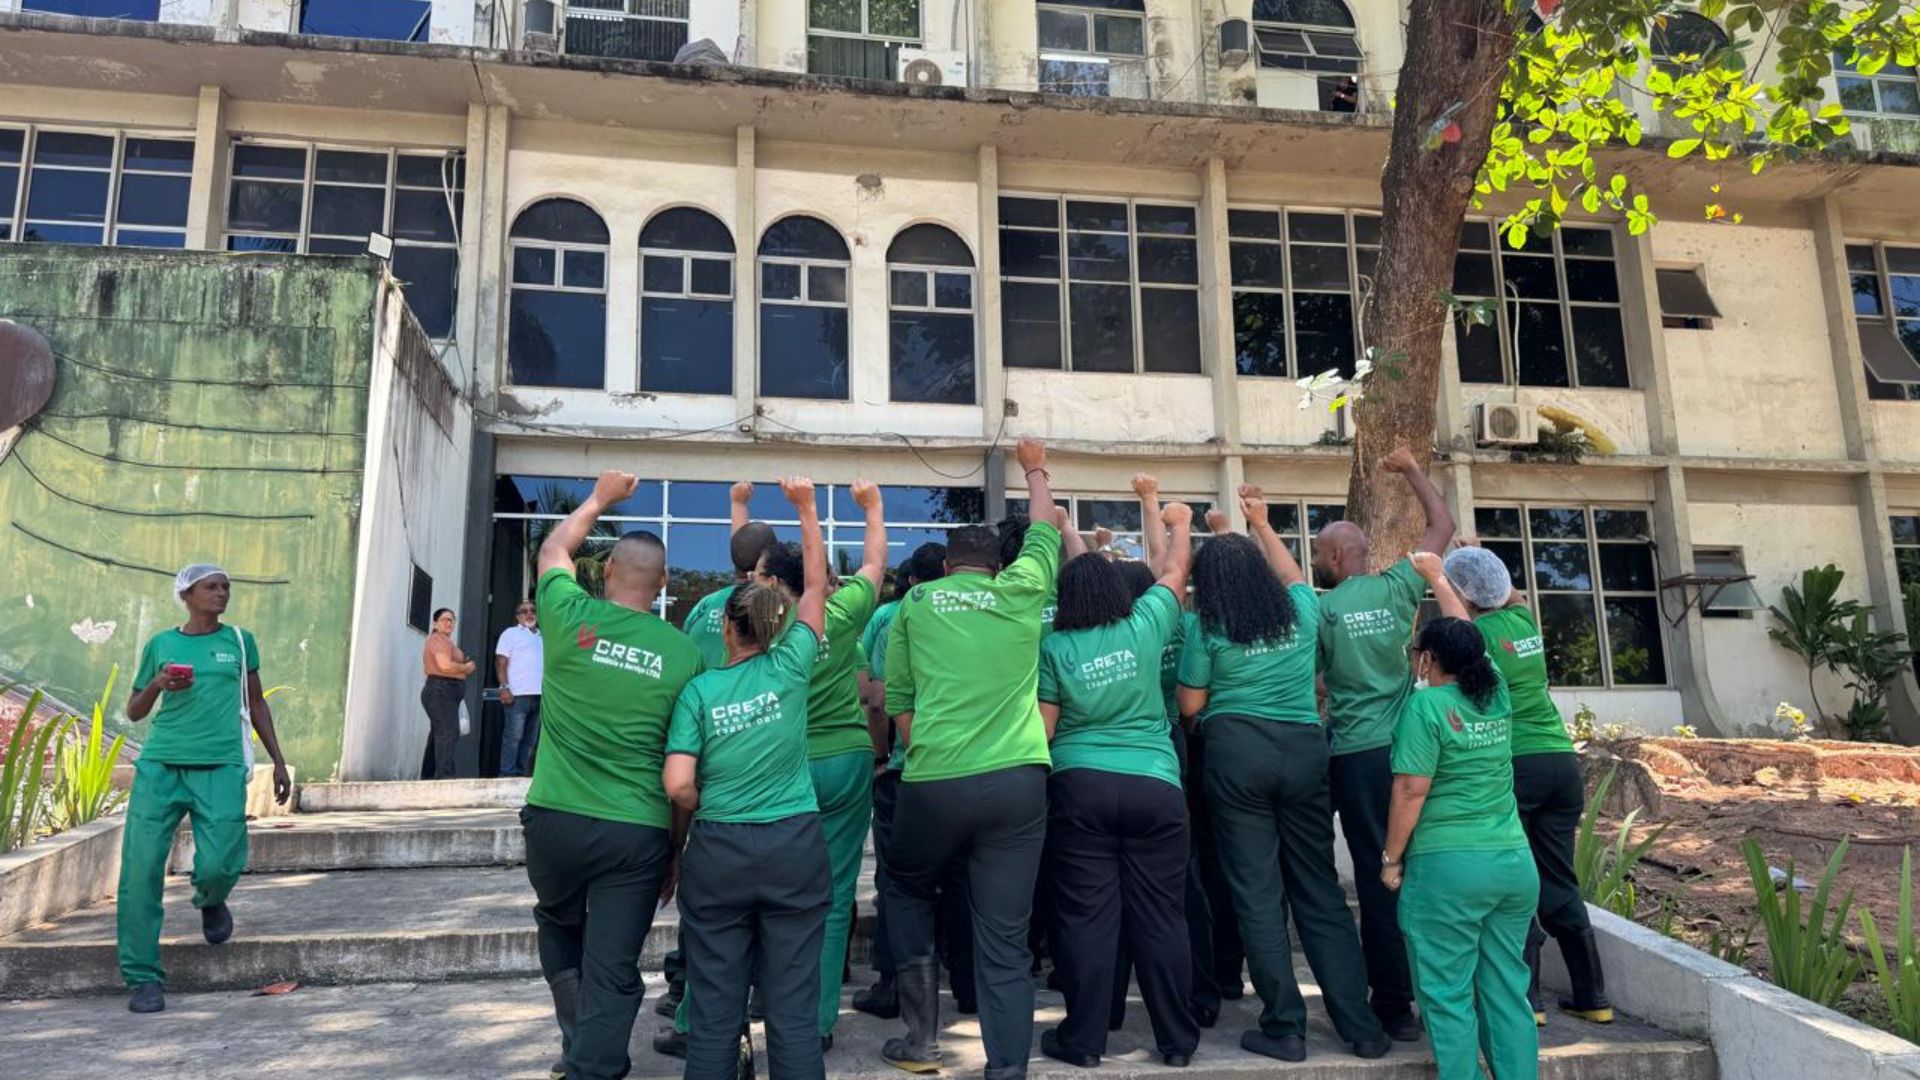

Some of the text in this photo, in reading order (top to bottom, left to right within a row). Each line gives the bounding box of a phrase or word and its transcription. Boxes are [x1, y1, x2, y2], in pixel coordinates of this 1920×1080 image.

[932, 590, 995, 601] CRETA
[1343, 608, 1391, 623] CRETA
[595, 638, 662, 672] CRETA
[1081, 649, 1136, 672] CRETA
[712, 691, 779, 719] CRETA
